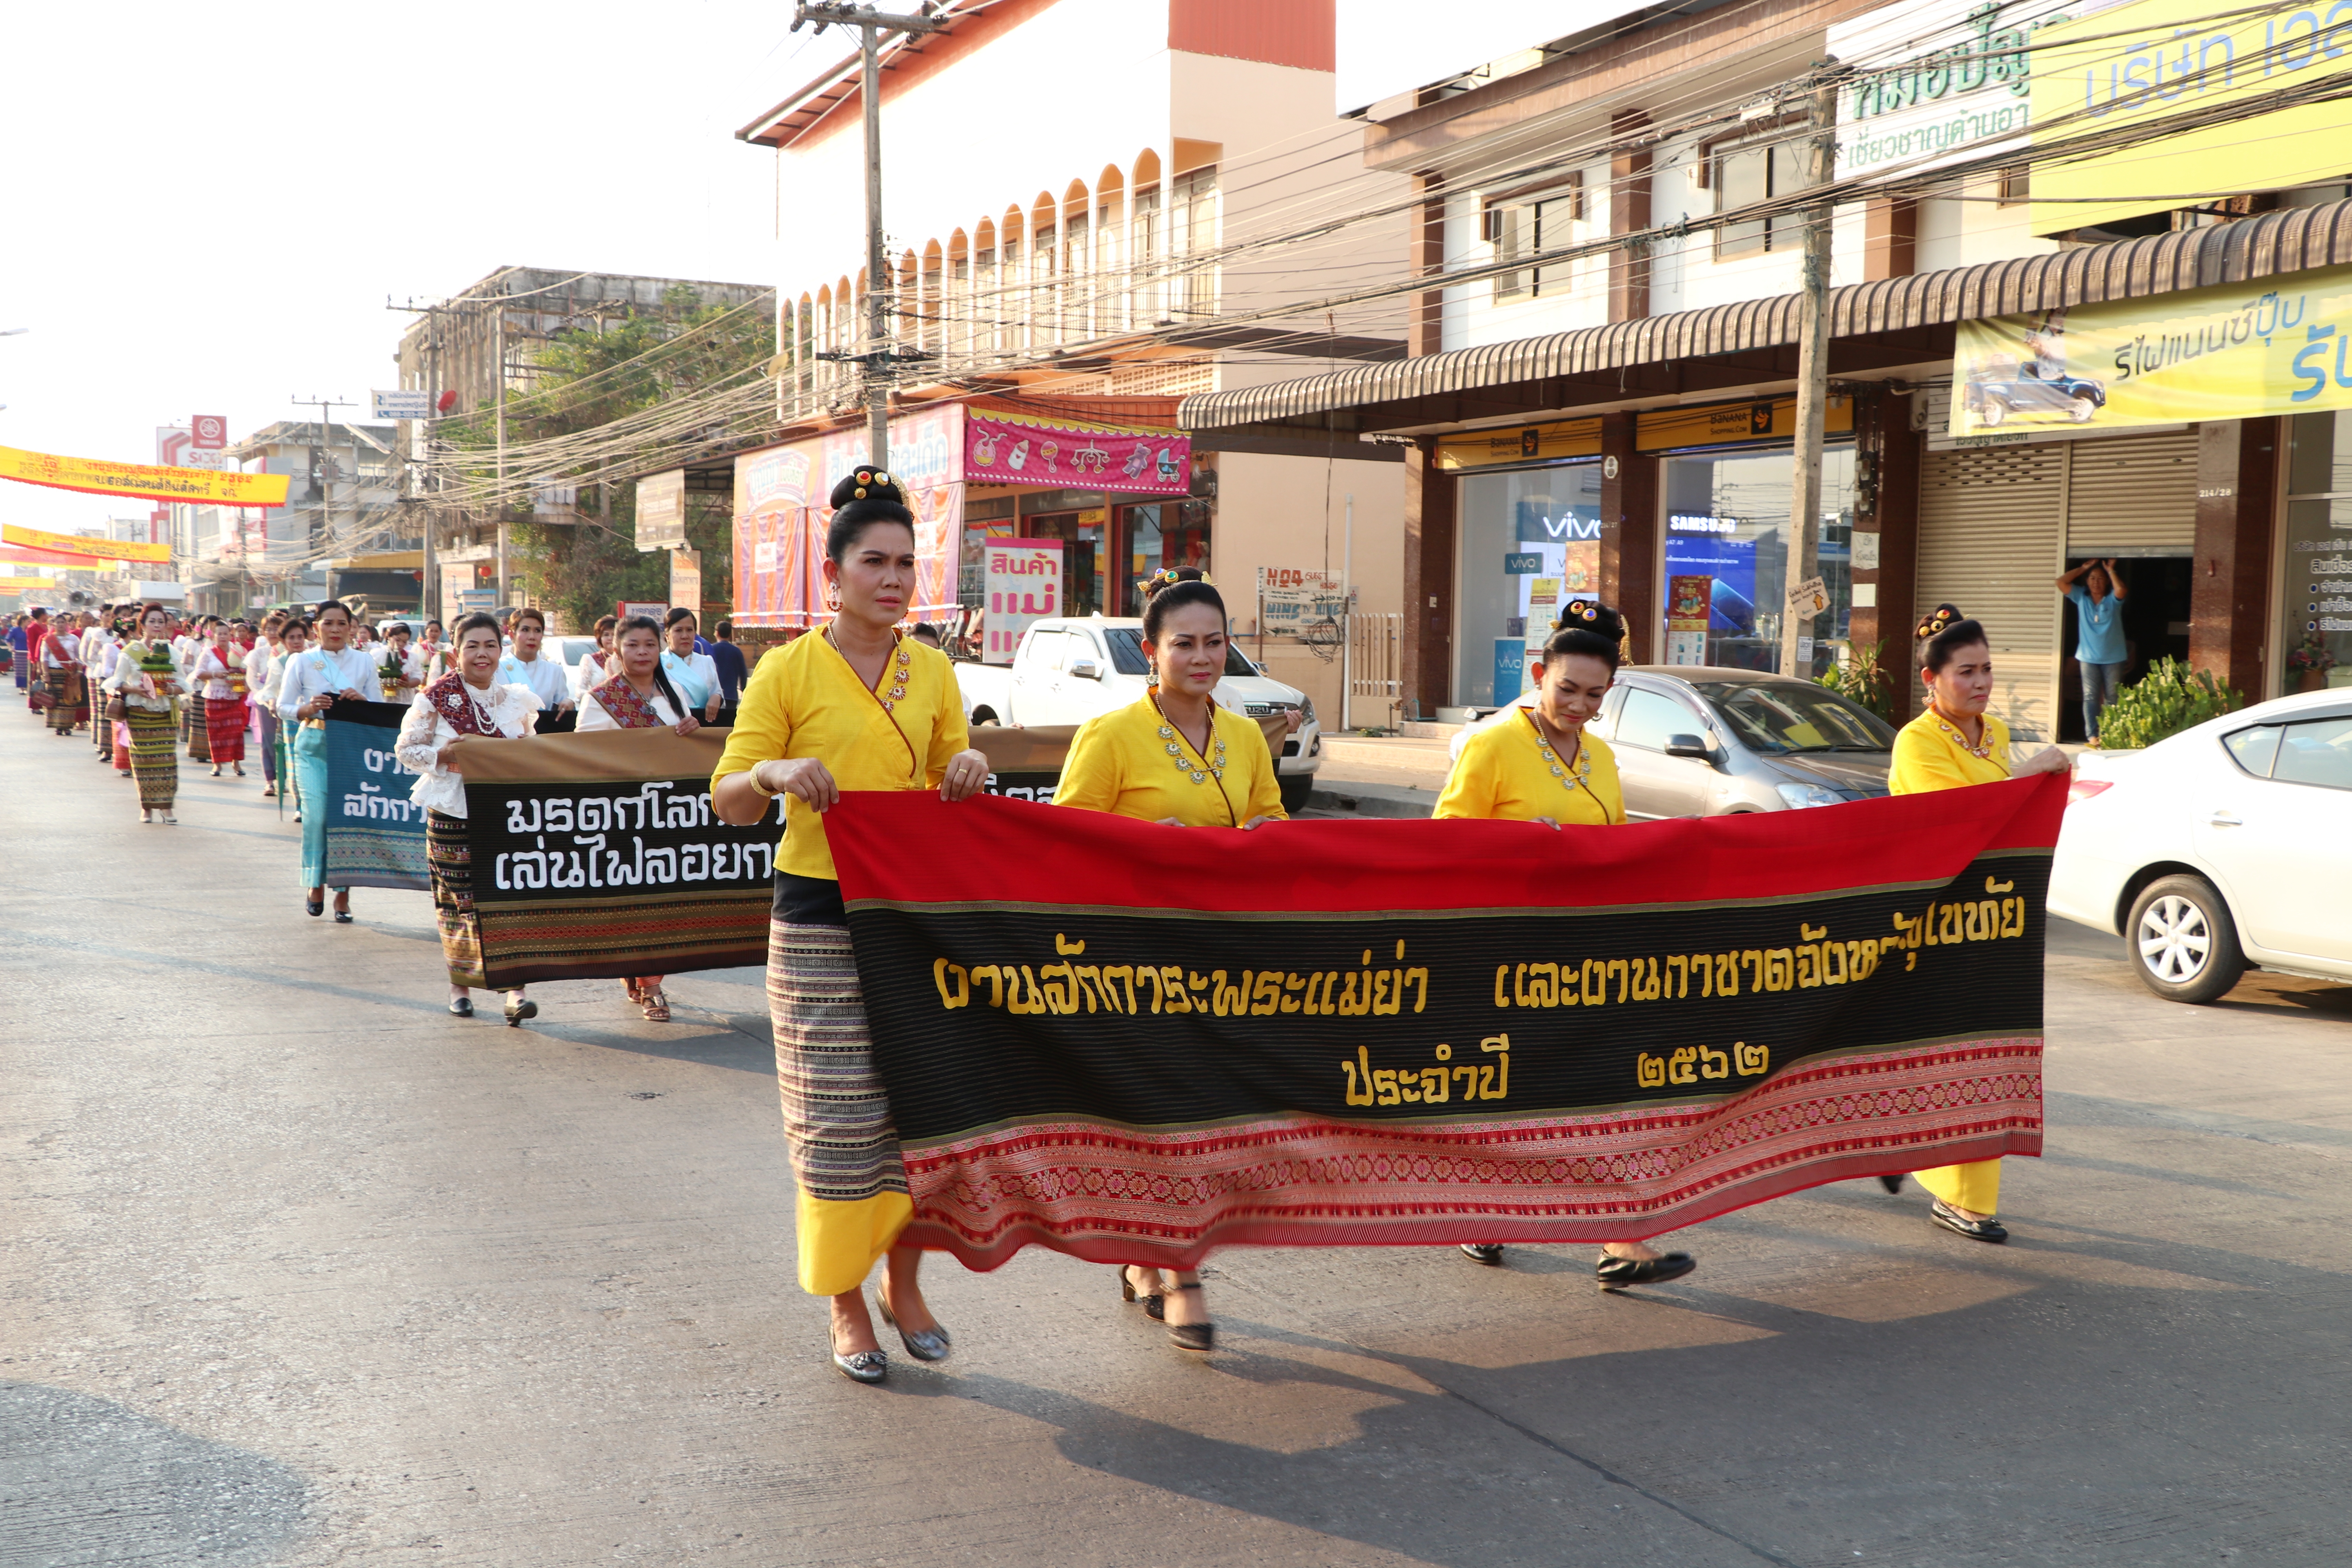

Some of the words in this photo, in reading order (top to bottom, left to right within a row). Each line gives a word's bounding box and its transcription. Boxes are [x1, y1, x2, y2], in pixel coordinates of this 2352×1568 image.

[2085, 28, 2233, 118] บริษัท
[2199, 487, 2232, 498] 214/28
[990, 552, 1057, 575] สินค้า
[1511, 556, 1536, 569] vivo
[991, 583, 1054, 615] แม่
[2319, 595, 2352, 612] เช่าซื้อ
[1498, 656, 1522, 668] vivo
[364, 748, 421, 775] งา
[495, 833, 782, 890] เล่นไฟลอยก
[933, 933, 1428, 1016] งานสักการะพระแม่ย่า
[1341, 1033, 1510, 1106] ประจำปี
[1637, 1041, 1769, 1087] ๒๕๖๒
